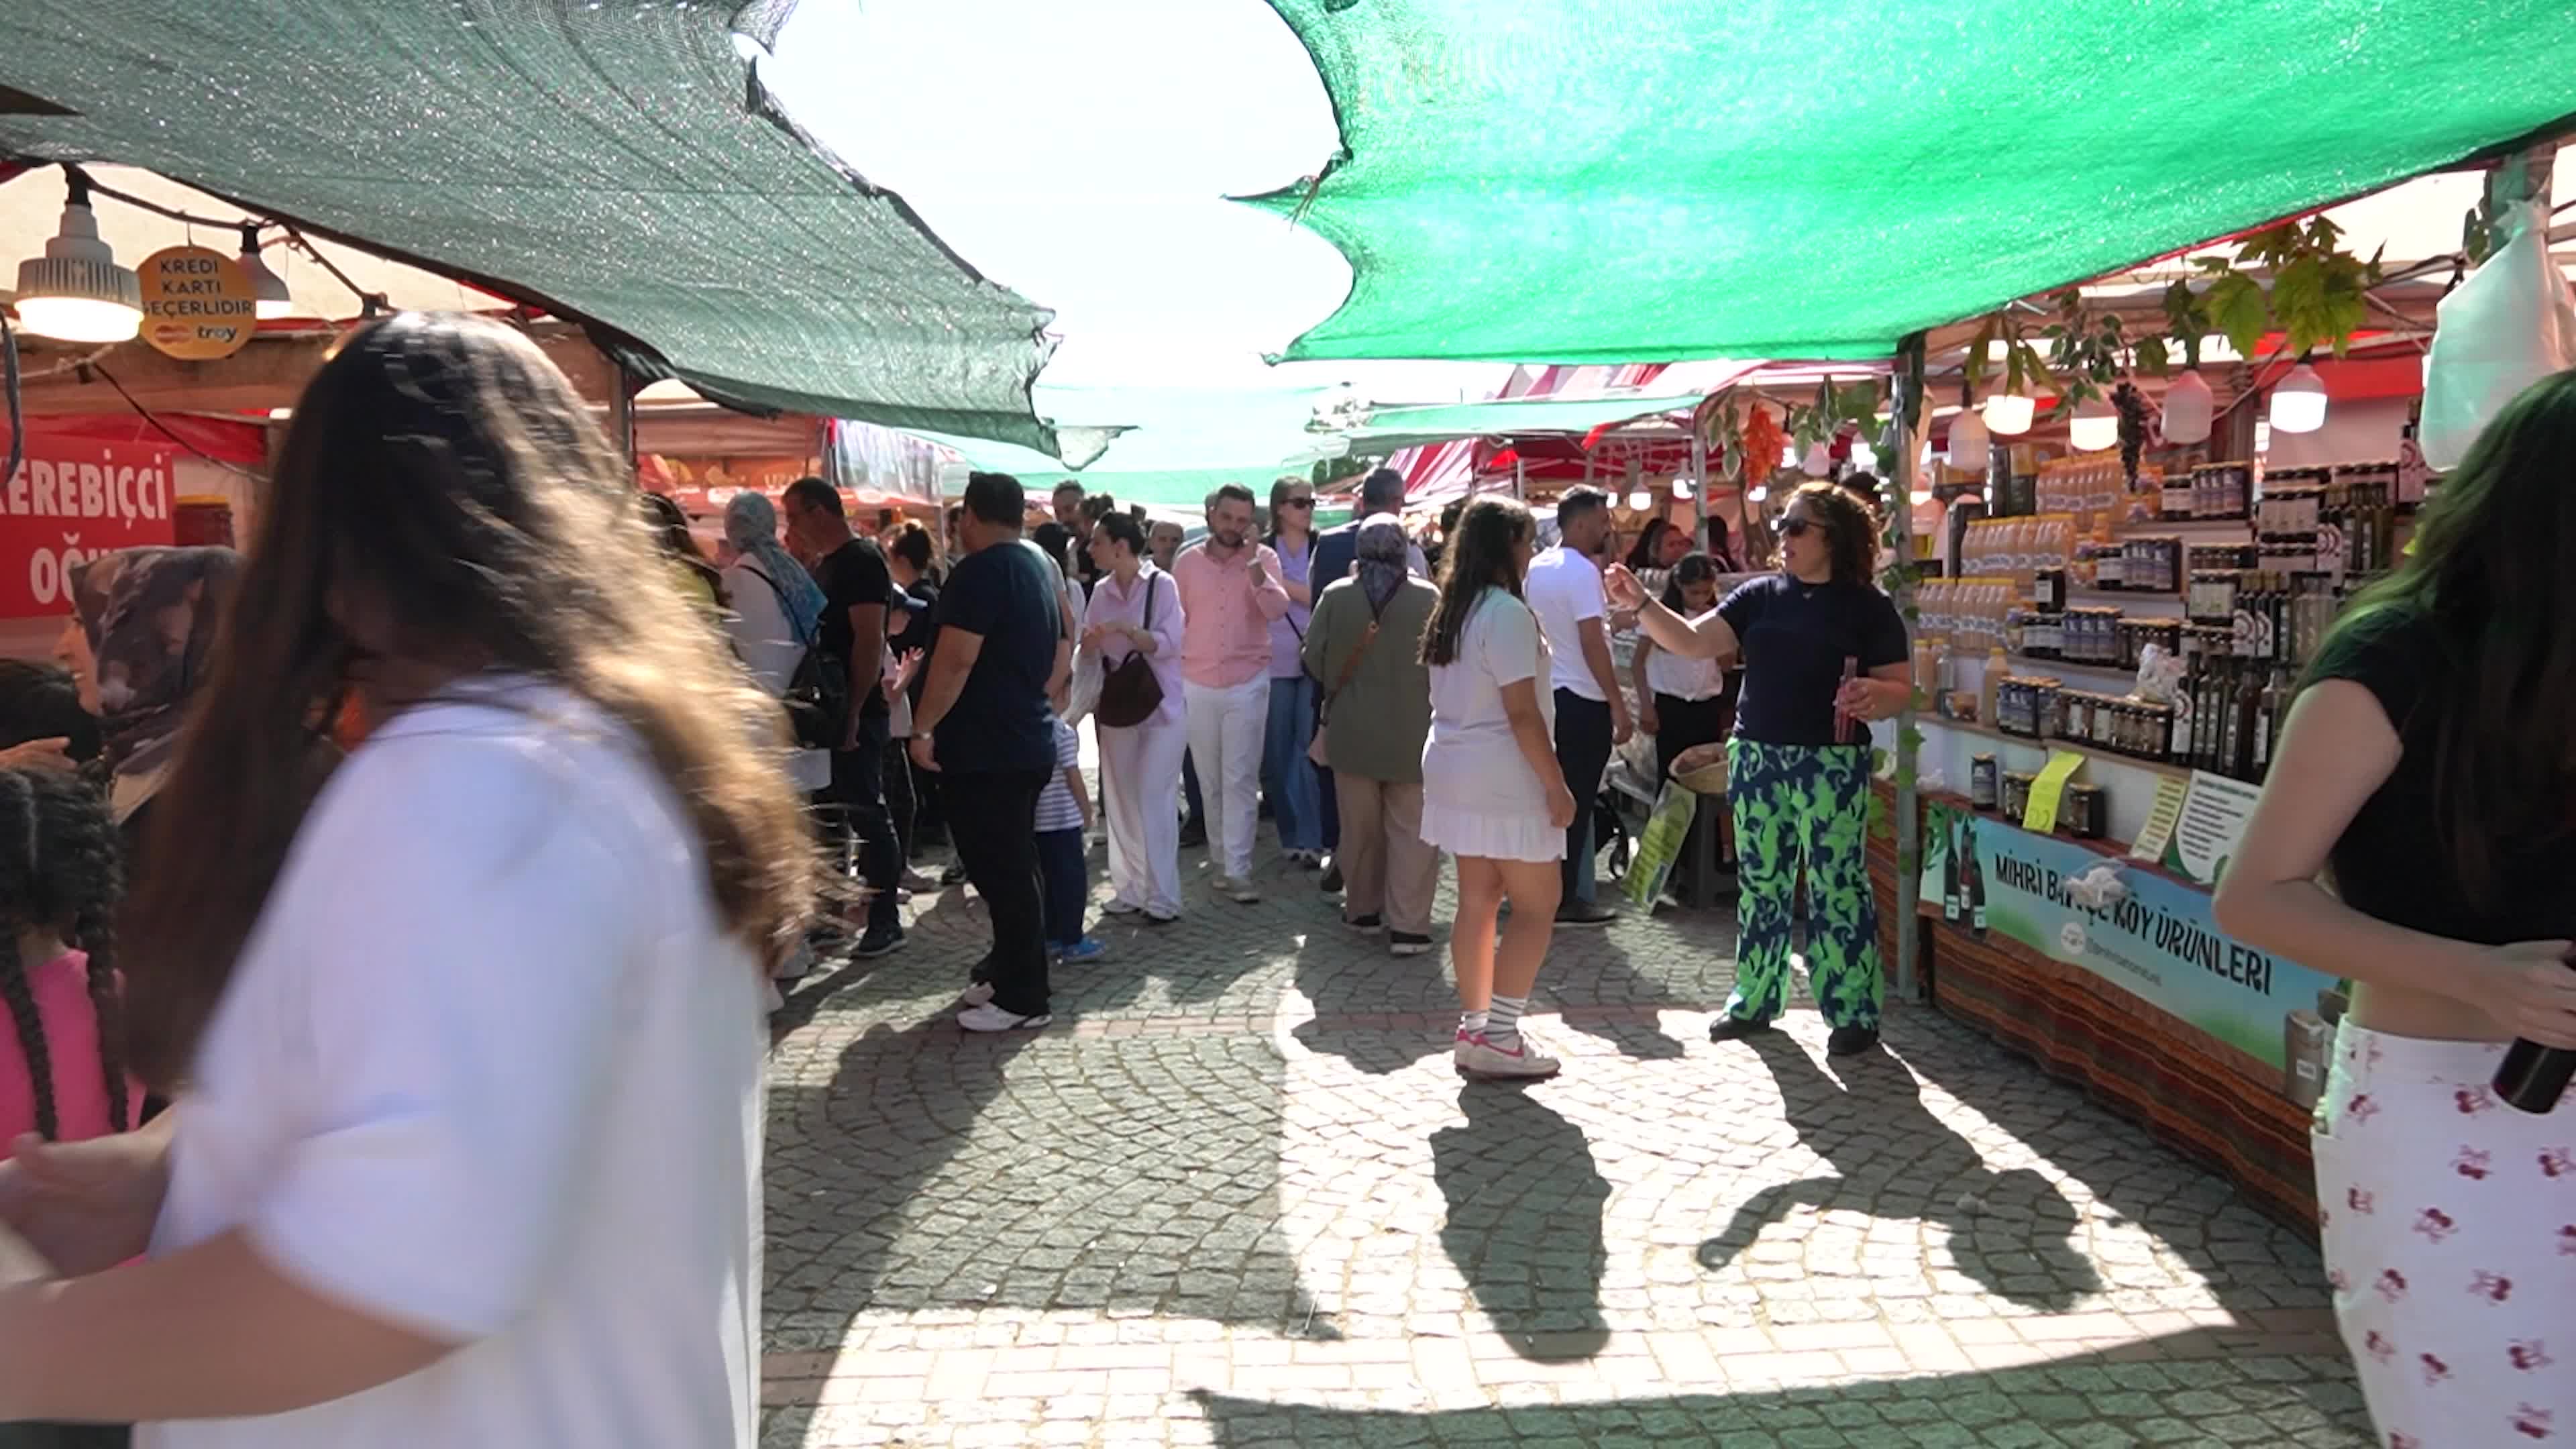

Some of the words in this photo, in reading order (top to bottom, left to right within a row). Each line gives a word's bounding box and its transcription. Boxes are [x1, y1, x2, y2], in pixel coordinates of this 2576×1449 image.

[162, 280, 221, 294] KARTI
[198, 325, 236, 343] troy
[1995, 848, 2043, 896] MİHRİ
[2114, 892, 2153, 941] KÖY
